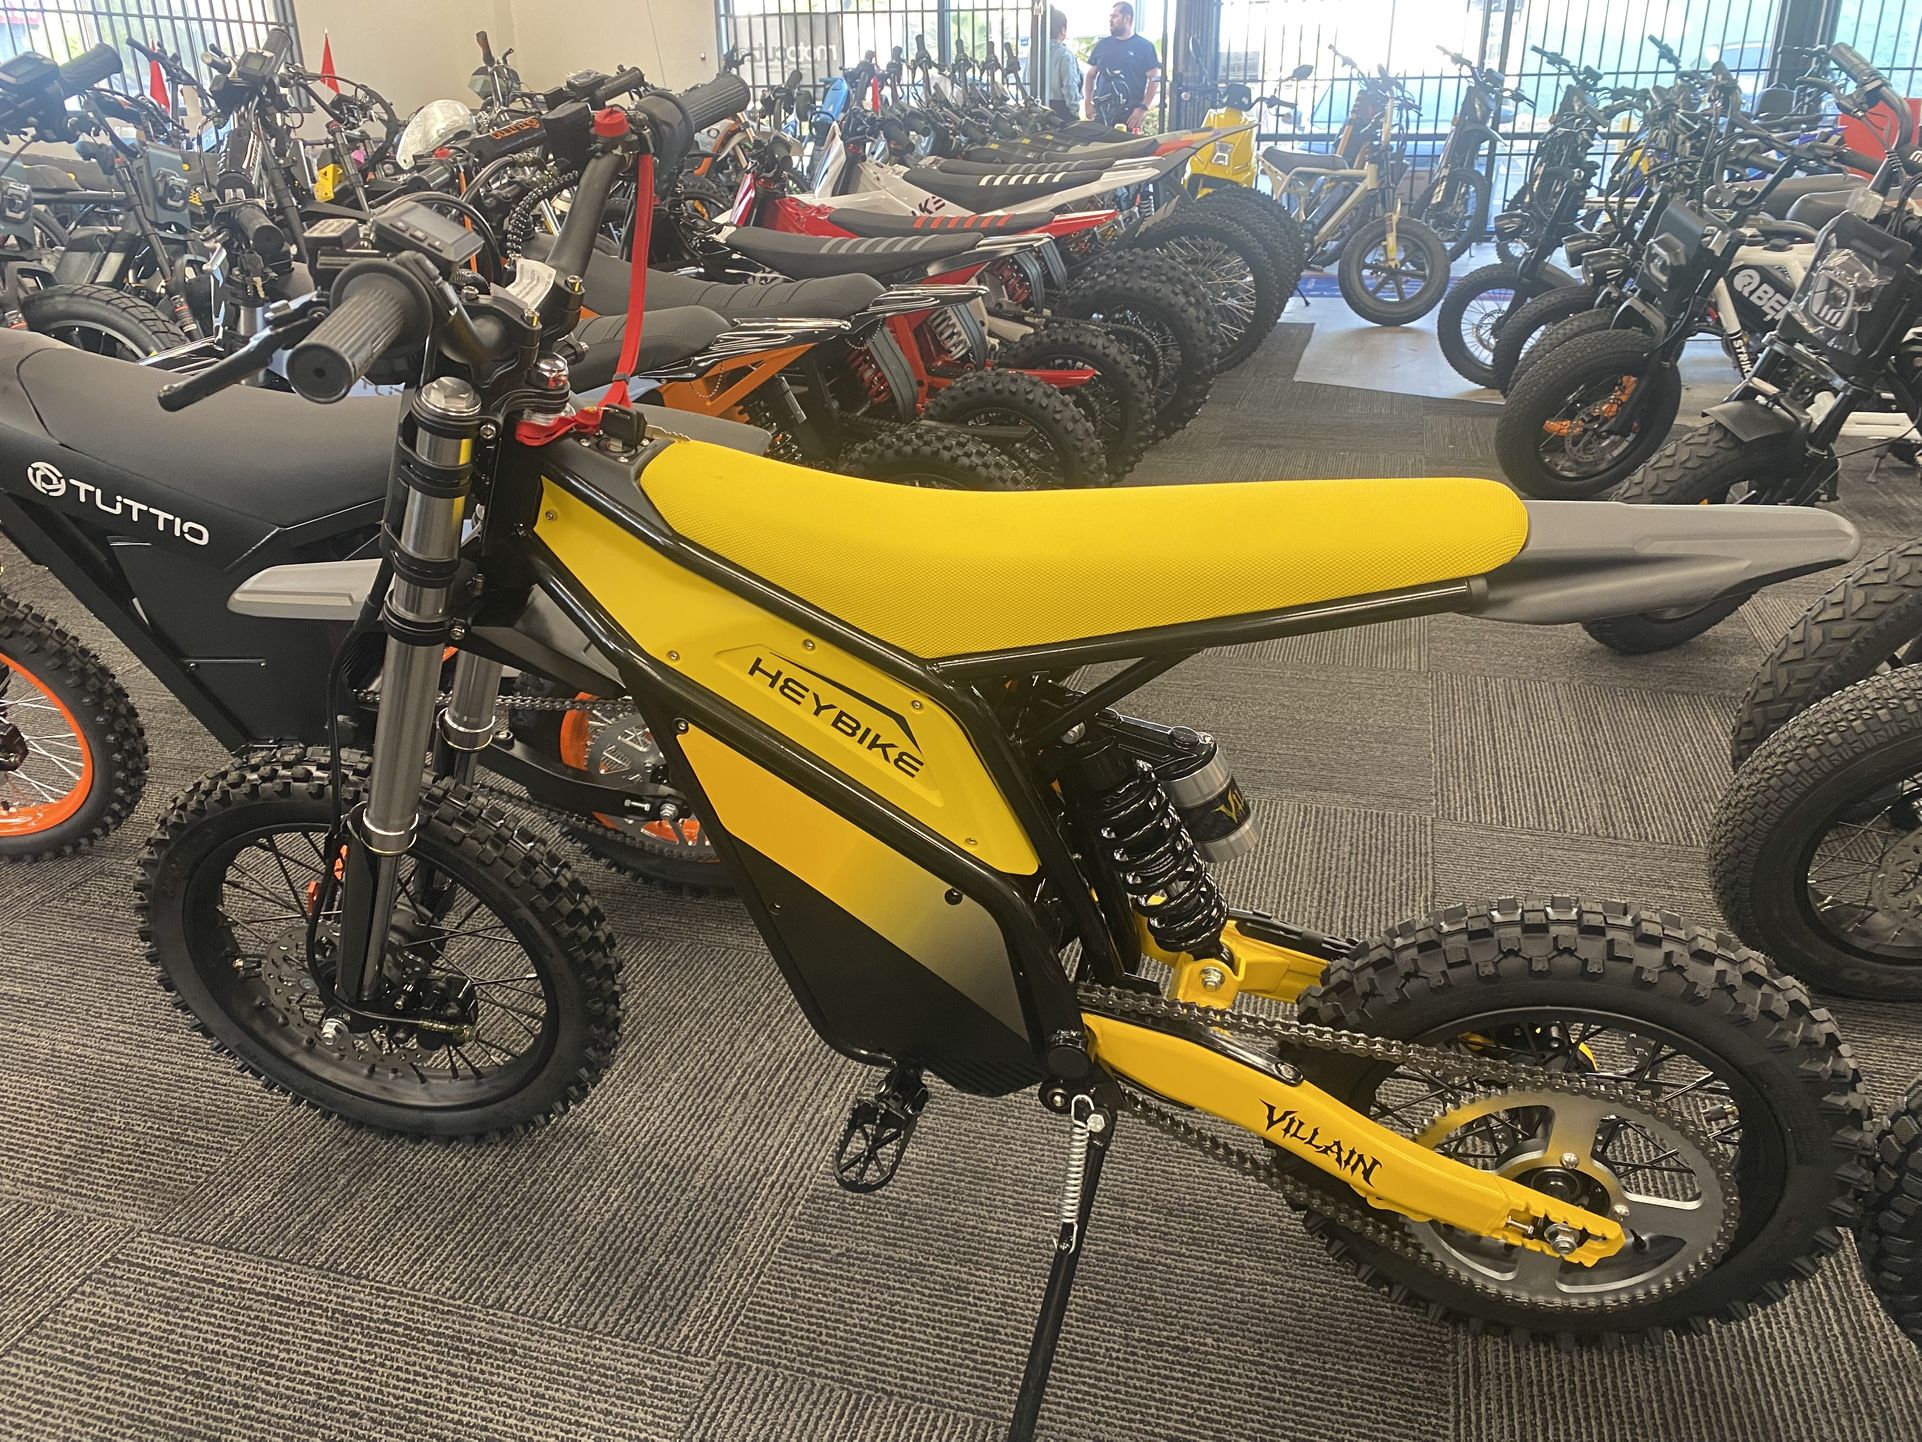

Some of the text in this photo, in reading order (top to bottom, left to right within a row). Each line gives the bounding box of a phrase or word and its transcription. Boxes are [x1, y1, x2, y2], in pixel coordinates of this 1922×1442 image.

[69, 478, 209, 546] TUTTIO
[748, 657, 924, 778] HEYBIKE
[1258, 1098, 1383, 1189] VILLAIN
